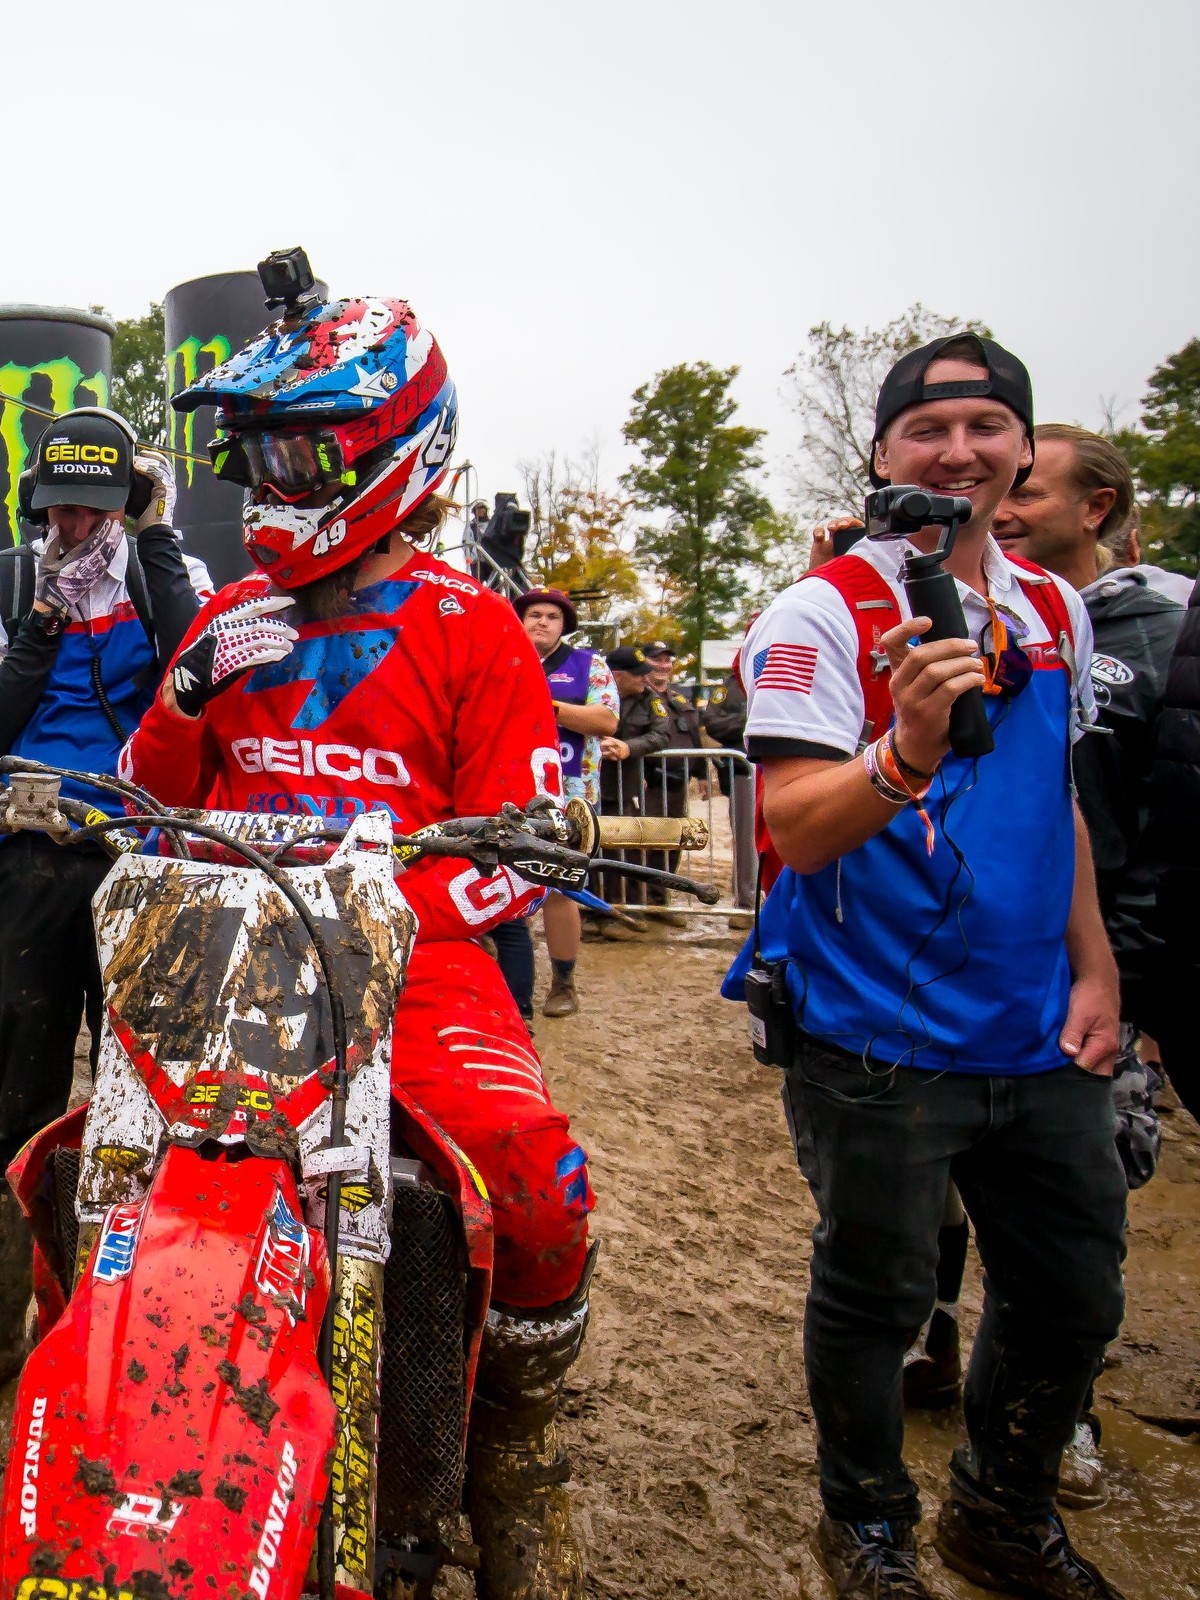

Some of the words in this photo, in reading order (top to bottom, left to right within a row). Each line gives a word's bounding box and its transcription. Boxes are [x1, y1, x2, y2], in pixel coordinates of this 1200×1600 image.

[45, 444, 119, 465] GEICO
[52, 463, 113, 477] HONDA
[316, 442, 333, 474] 100%
[311, 518, 347, 556] 49
[410, 570, 480, 596] GEICO
[1091, 658, 1128, 682] iroh
[230, 736, 412, 788] GEICO
[244, 791, 404, 824] HONDA
[17, 1395, 48, 1538] DUNLOP
[249, 1440, 297, 1600] DUNLOP
